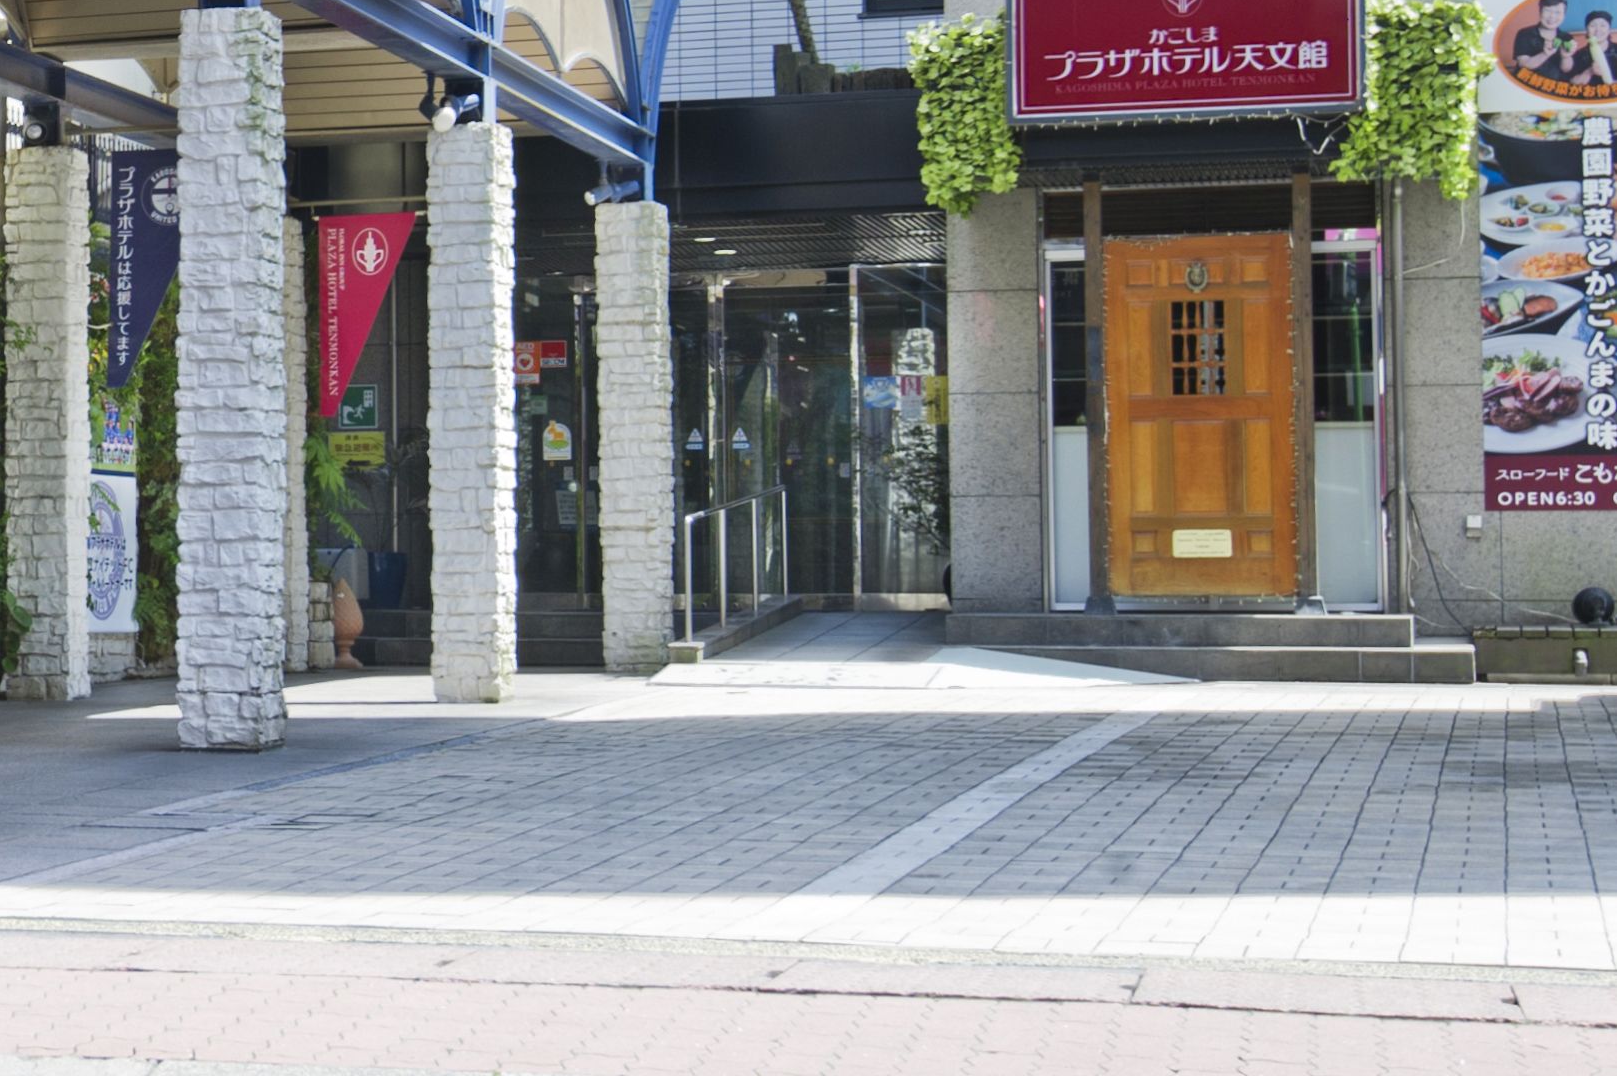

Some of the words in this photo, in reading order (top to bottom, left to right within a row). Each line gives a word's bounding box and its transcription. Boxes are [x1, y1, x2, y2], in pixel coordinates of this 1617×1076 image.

[1148, 26, 1220, 45] かごしま
[1043, 40, 1329, 81] プラザホテル天文館
[1055, 80, 1133, 95] KAGOSHIMA
[1135, 78, 1178, 92] PLAZA
[1182, 76, 1227, 89] HOTEL
[1230, 72, 1317, 87] TENMONKAN
[115, 166, 136, 366] プラザホテルは応援してます
[327, 227, 338, 269] PLAZA
[327, 272, 338, 314] HOTEL
[328, 316, 339, 396] TENMONKAN
[1494, 467, 1570, 482] スローフード
[1574, 462, 1617, 484] こも
